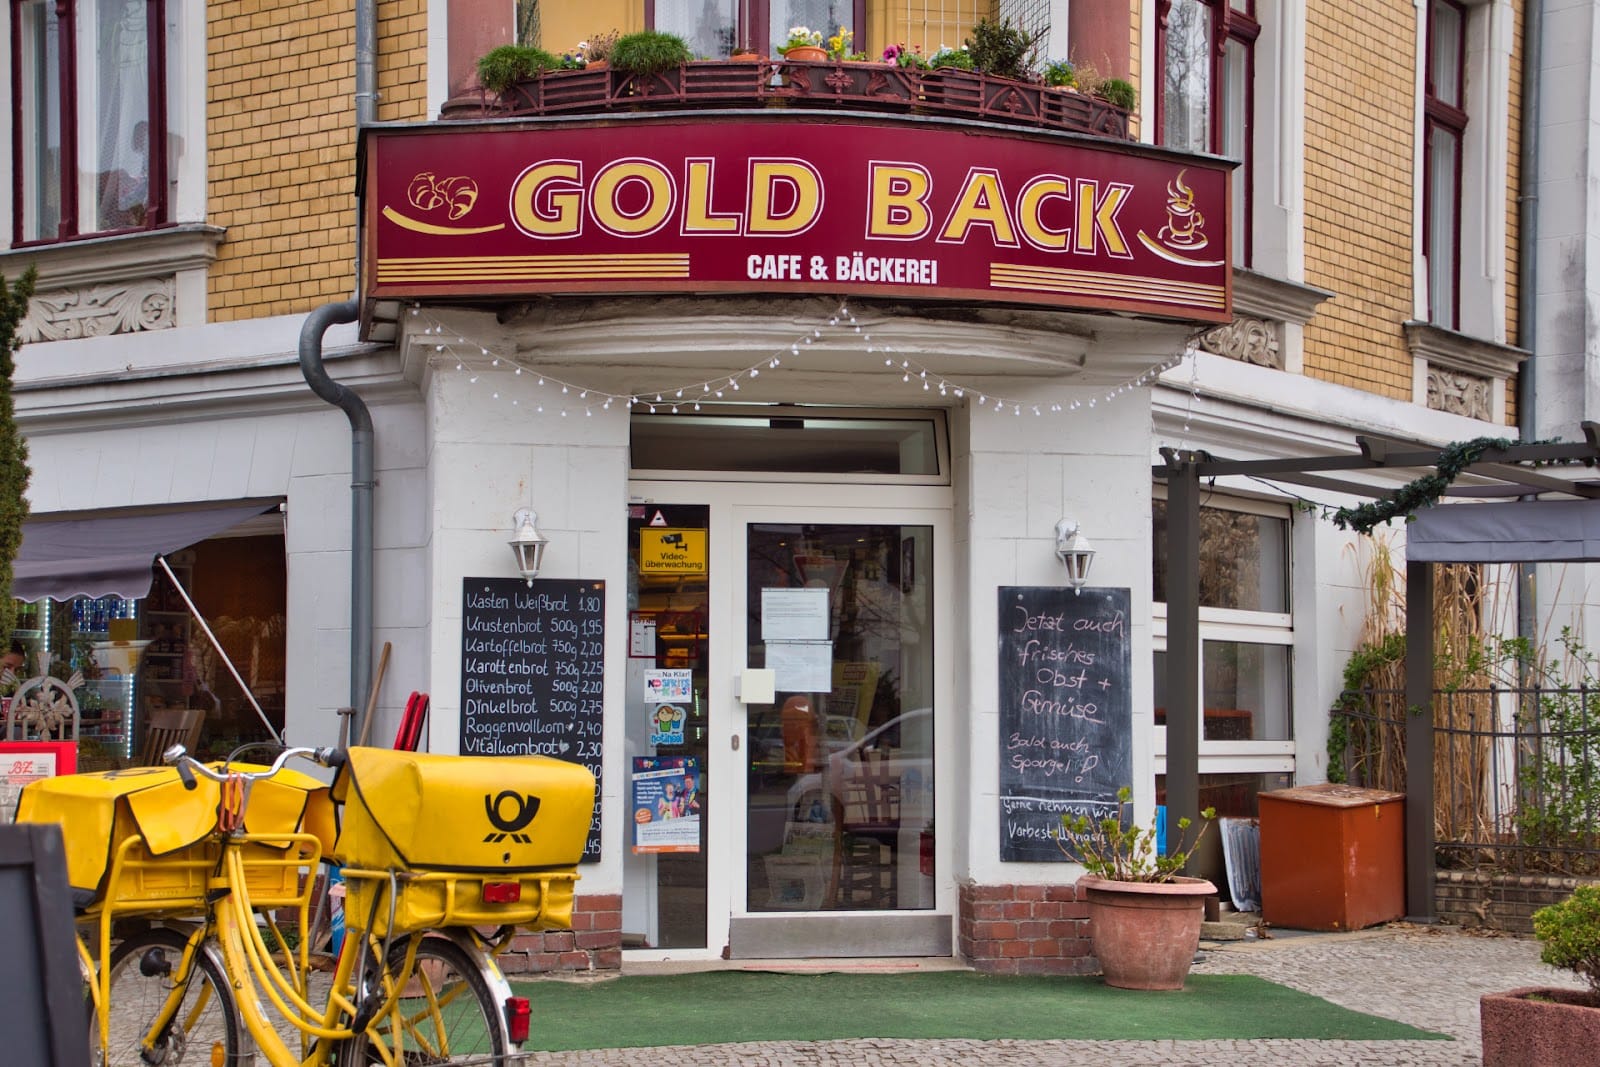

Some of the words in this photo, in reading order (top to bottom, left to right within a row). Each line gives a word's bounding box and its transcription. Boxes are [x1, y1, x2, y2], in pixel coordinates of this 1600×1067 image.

[509, 157, 825, 240] GOLD
[865, 160, 1134, 260] BACK
[747, 254, 801, 279] CAFE
[810, 256, 828, 280] &
[836, 251, 937, 284] BÄCKEREI
[645, 560, 702, 570] überwachung
[660, 552, 688, 560] Video-
[466, 593, 509, 609] Kasten
[515, 592, 569, 613] Weißbrot
[578, 597, 600, 612] 1,80
[466, 615, 542, 633] Krustenbrot
[550, 618, 578, 639] 500g
[581, 619, 603, 637] 1,95
[1014, 606, 1064, 632] Jetzt
[1074, 611, 1124, 638] auch
[465, 638, 547, 657] Kartoffelbrot
[552, 640, 577, 662] 750g
[580, 641, 602, 658] 2,20
[1019, 640, 1095, 667] frisches
[465, 658, 549, 676] Karottenbrot
[555, 660, 579, 684] 750g
[581, 661, 603, 677] 2,25
[1037, 668, 1088, 689] Obst
[1098, 679, 1112, 690] +
[465, 678, 533, 694] Olivenbrot
[552, 680, 578, 699] 500g
[580, 680, 602, 695] 2,20
[465, 698, 538, 715] Dinkelbrot
[550, 699, 577, 720] 500g
[580, 700, 603, 716] 2,75
[1022, 690, 1105, 724] Gemüse
[577, 721, 602, 737] 2,40
[464, 737, 558, 754] Vitalkornbrot
[577, 741, 602, 759] 2,30
[1007, 732, 1046, 749] Bald
[1050, 737, 1089, 752] auch
[1092, 807, 1119, 819] wir
